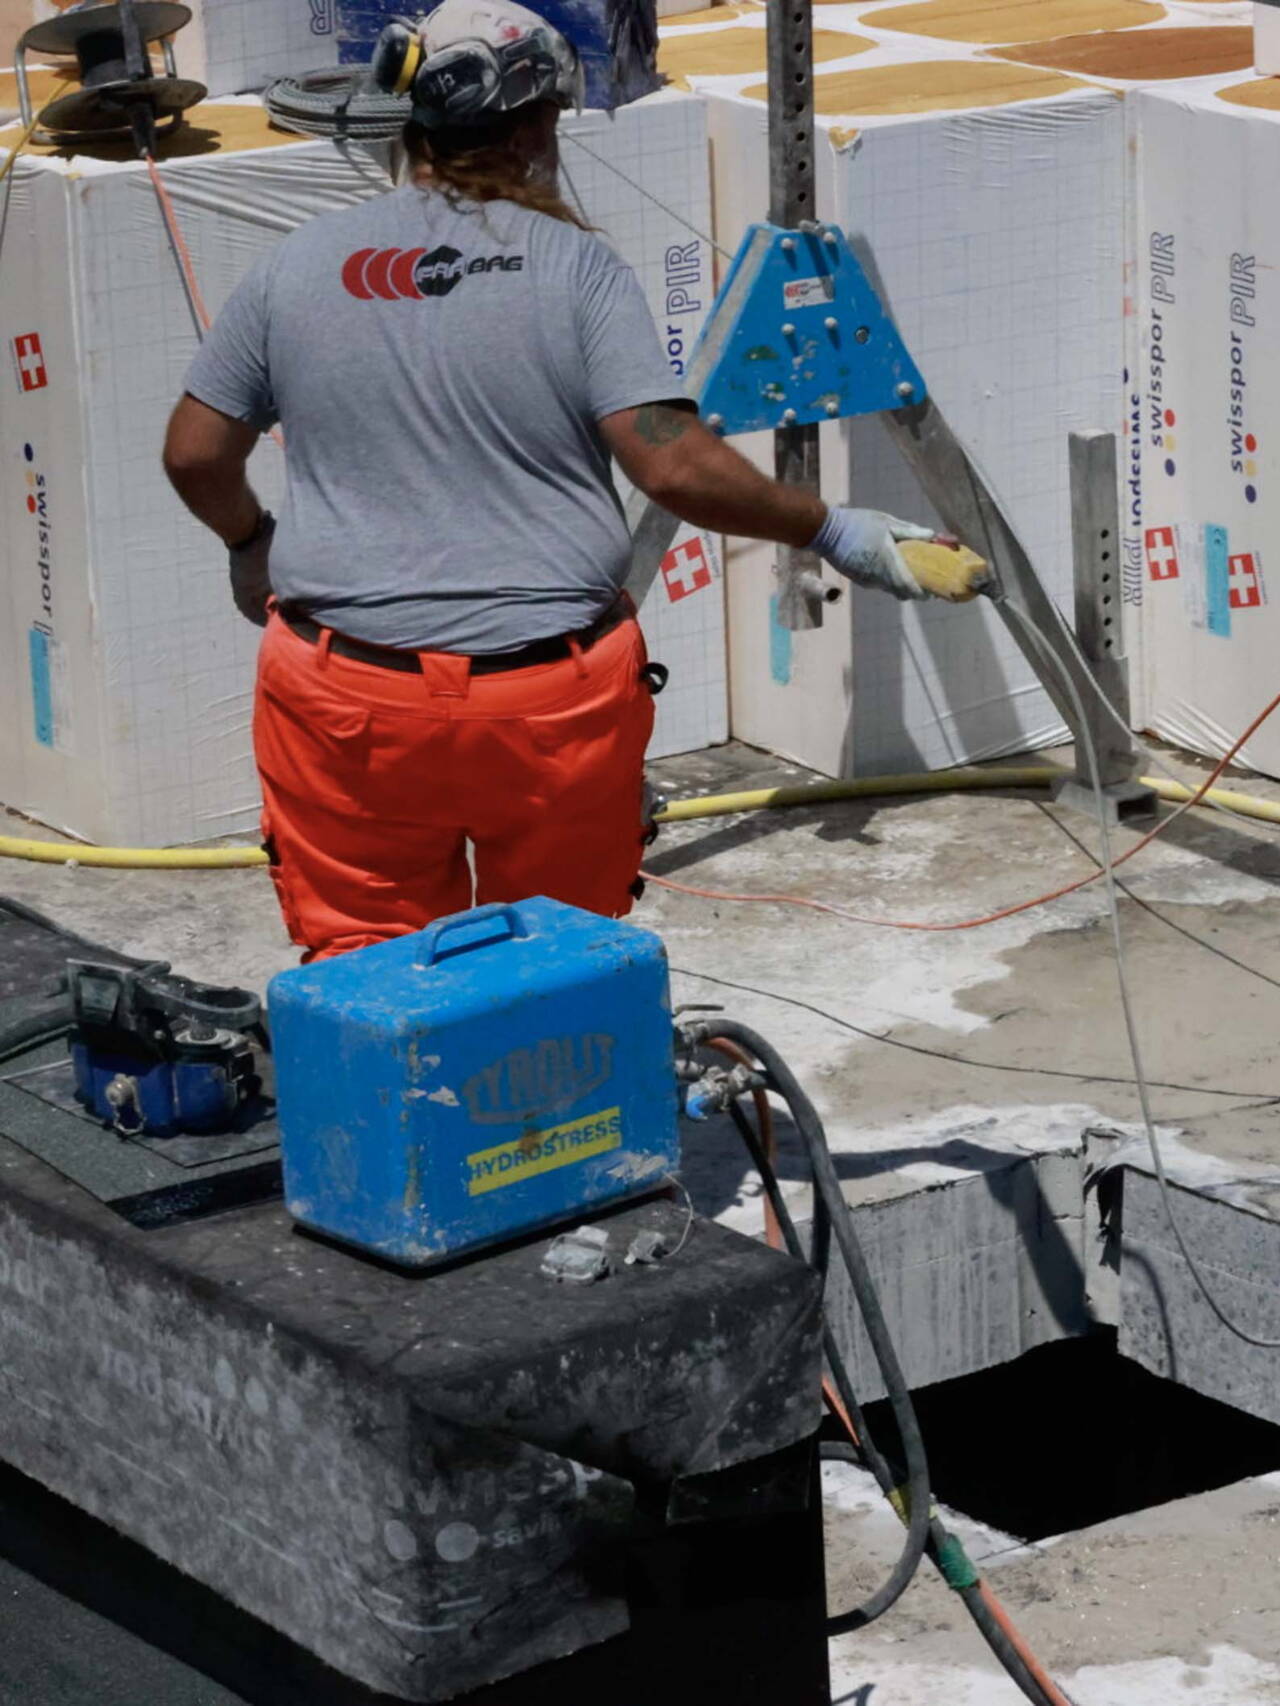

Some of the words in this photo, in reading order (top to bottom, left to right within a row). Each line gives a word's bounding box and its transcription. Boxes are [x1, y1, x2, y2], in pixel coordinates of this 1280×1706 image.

[665, 240, 701, 315] PIR
[1151, 231, 1175, 305] PIR
[1230, 252, 1256, 327] PIR
[1147, 308, 1167, 448] swisspor
[1227, 331, 1247, 474] swisspor
[34, 472, 54, 619] swisspor
[471, 1115, 621, 1181] HYDROSTRESS
